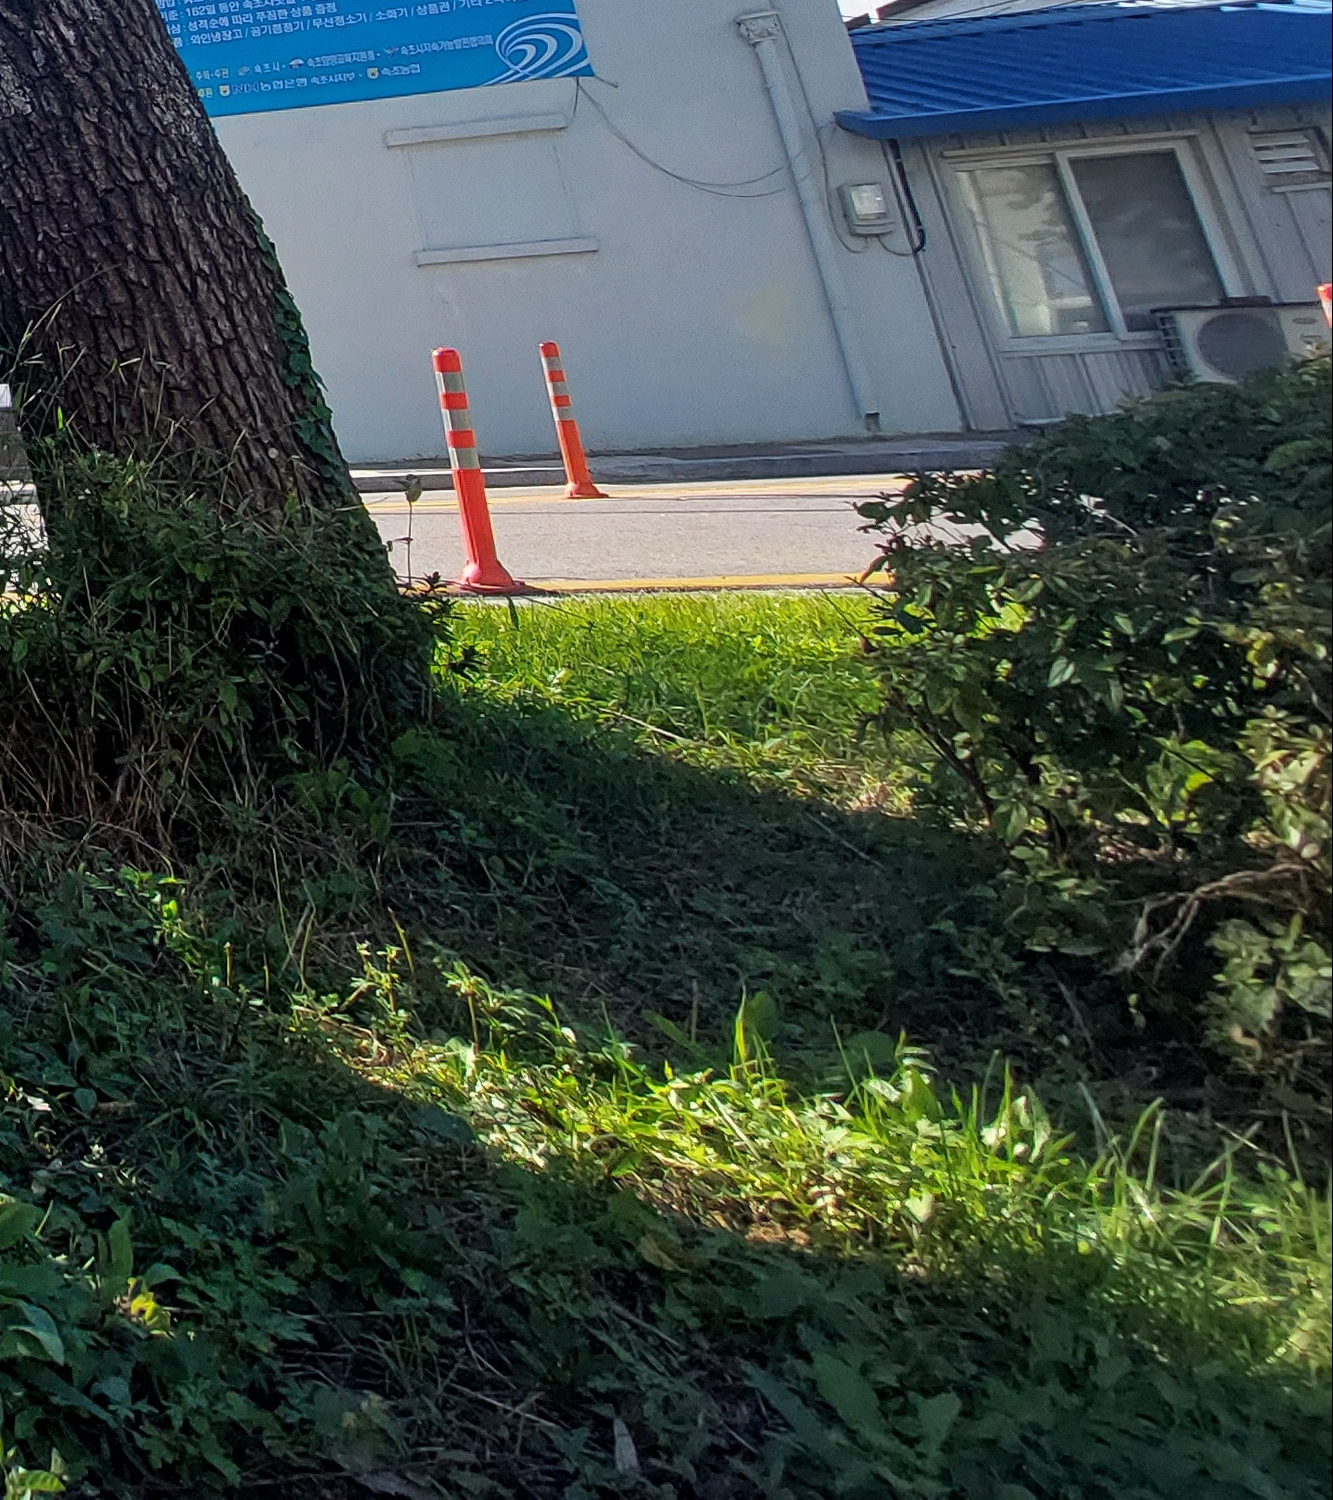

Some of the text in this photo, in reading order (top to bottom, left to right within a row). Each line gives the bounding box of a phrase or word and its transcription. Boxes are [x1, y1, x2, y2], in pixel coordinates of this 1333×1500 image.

[185, 4, 217, 17] 162일
[218, 1, 240, 14] 동안
[188, 16, 230, 32] 성적순에
[231, 12, 253, 26] 따라
[190, 28, 243, 45] 와인냉장고
[250, 20, 304, 37] 공기청정기
[312, 12, 368, 29] 무선청소기
[375, 7, 408, 21] 소화기
[416, 1, 450, 15] 상품권
